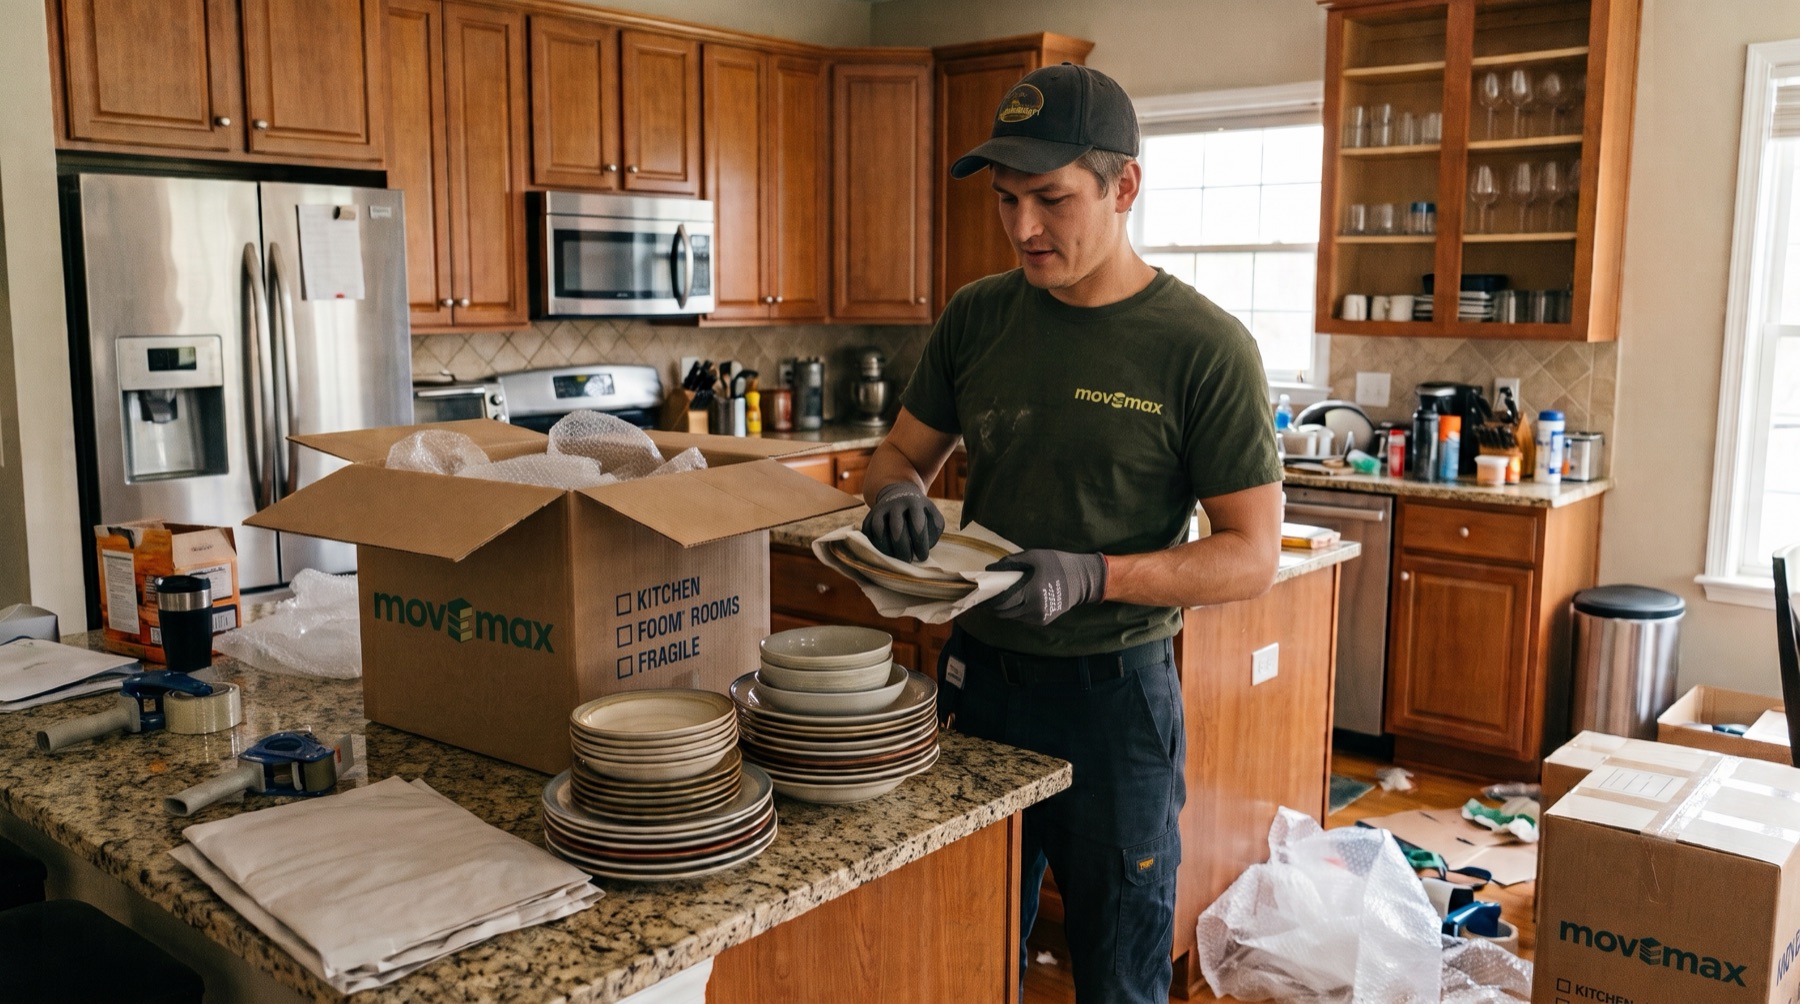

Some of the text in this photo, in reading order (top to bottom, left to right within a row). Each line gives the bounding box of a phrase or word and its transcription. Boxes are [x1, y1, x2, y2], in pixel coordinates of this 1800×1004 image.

[637, 576, 700, 611] KITCHEN
[691, 595, 740, 627] ROOMS
[638, 636, 700, 673] FRAGILE
